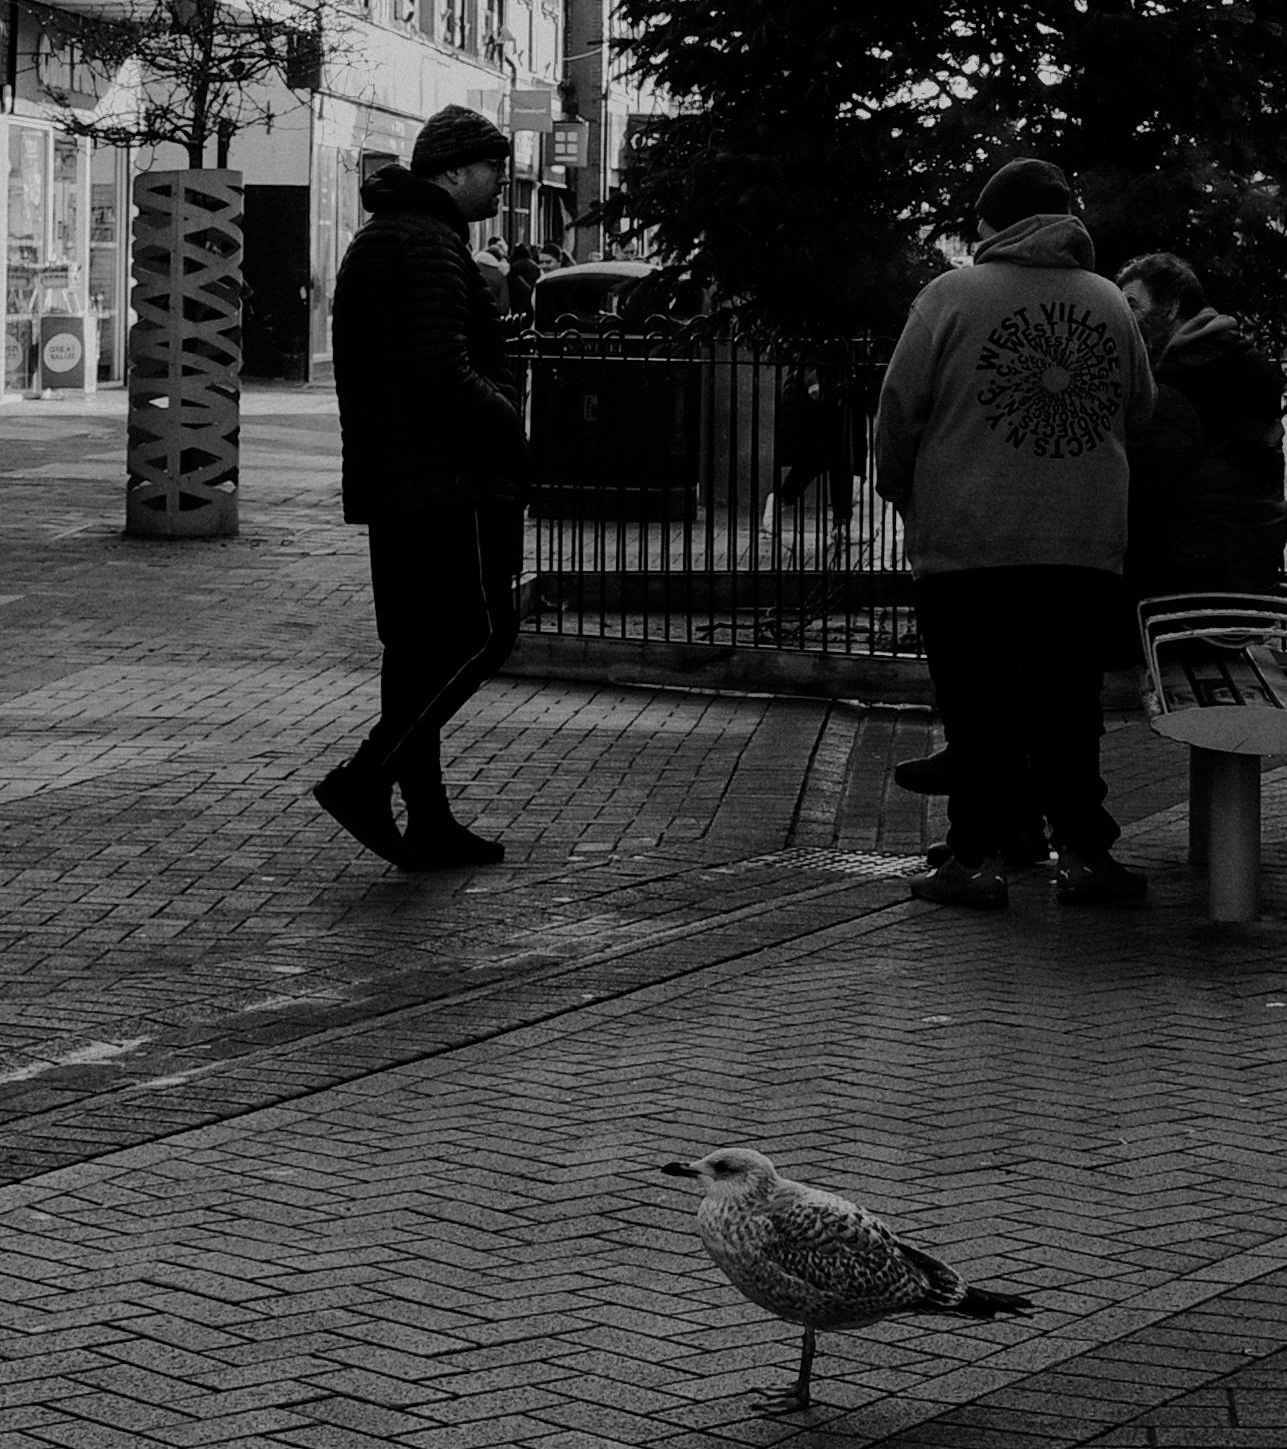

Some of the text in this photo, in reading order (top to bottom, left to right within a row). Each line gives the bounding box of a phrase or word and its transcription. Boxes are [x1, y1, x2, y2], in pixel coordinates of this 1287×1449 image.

[976, 307, 1029, 371] WEST
[1040, 302, 1119, 371] VILLAGE
[1034, 381, 1122, 458] PROJECTS
